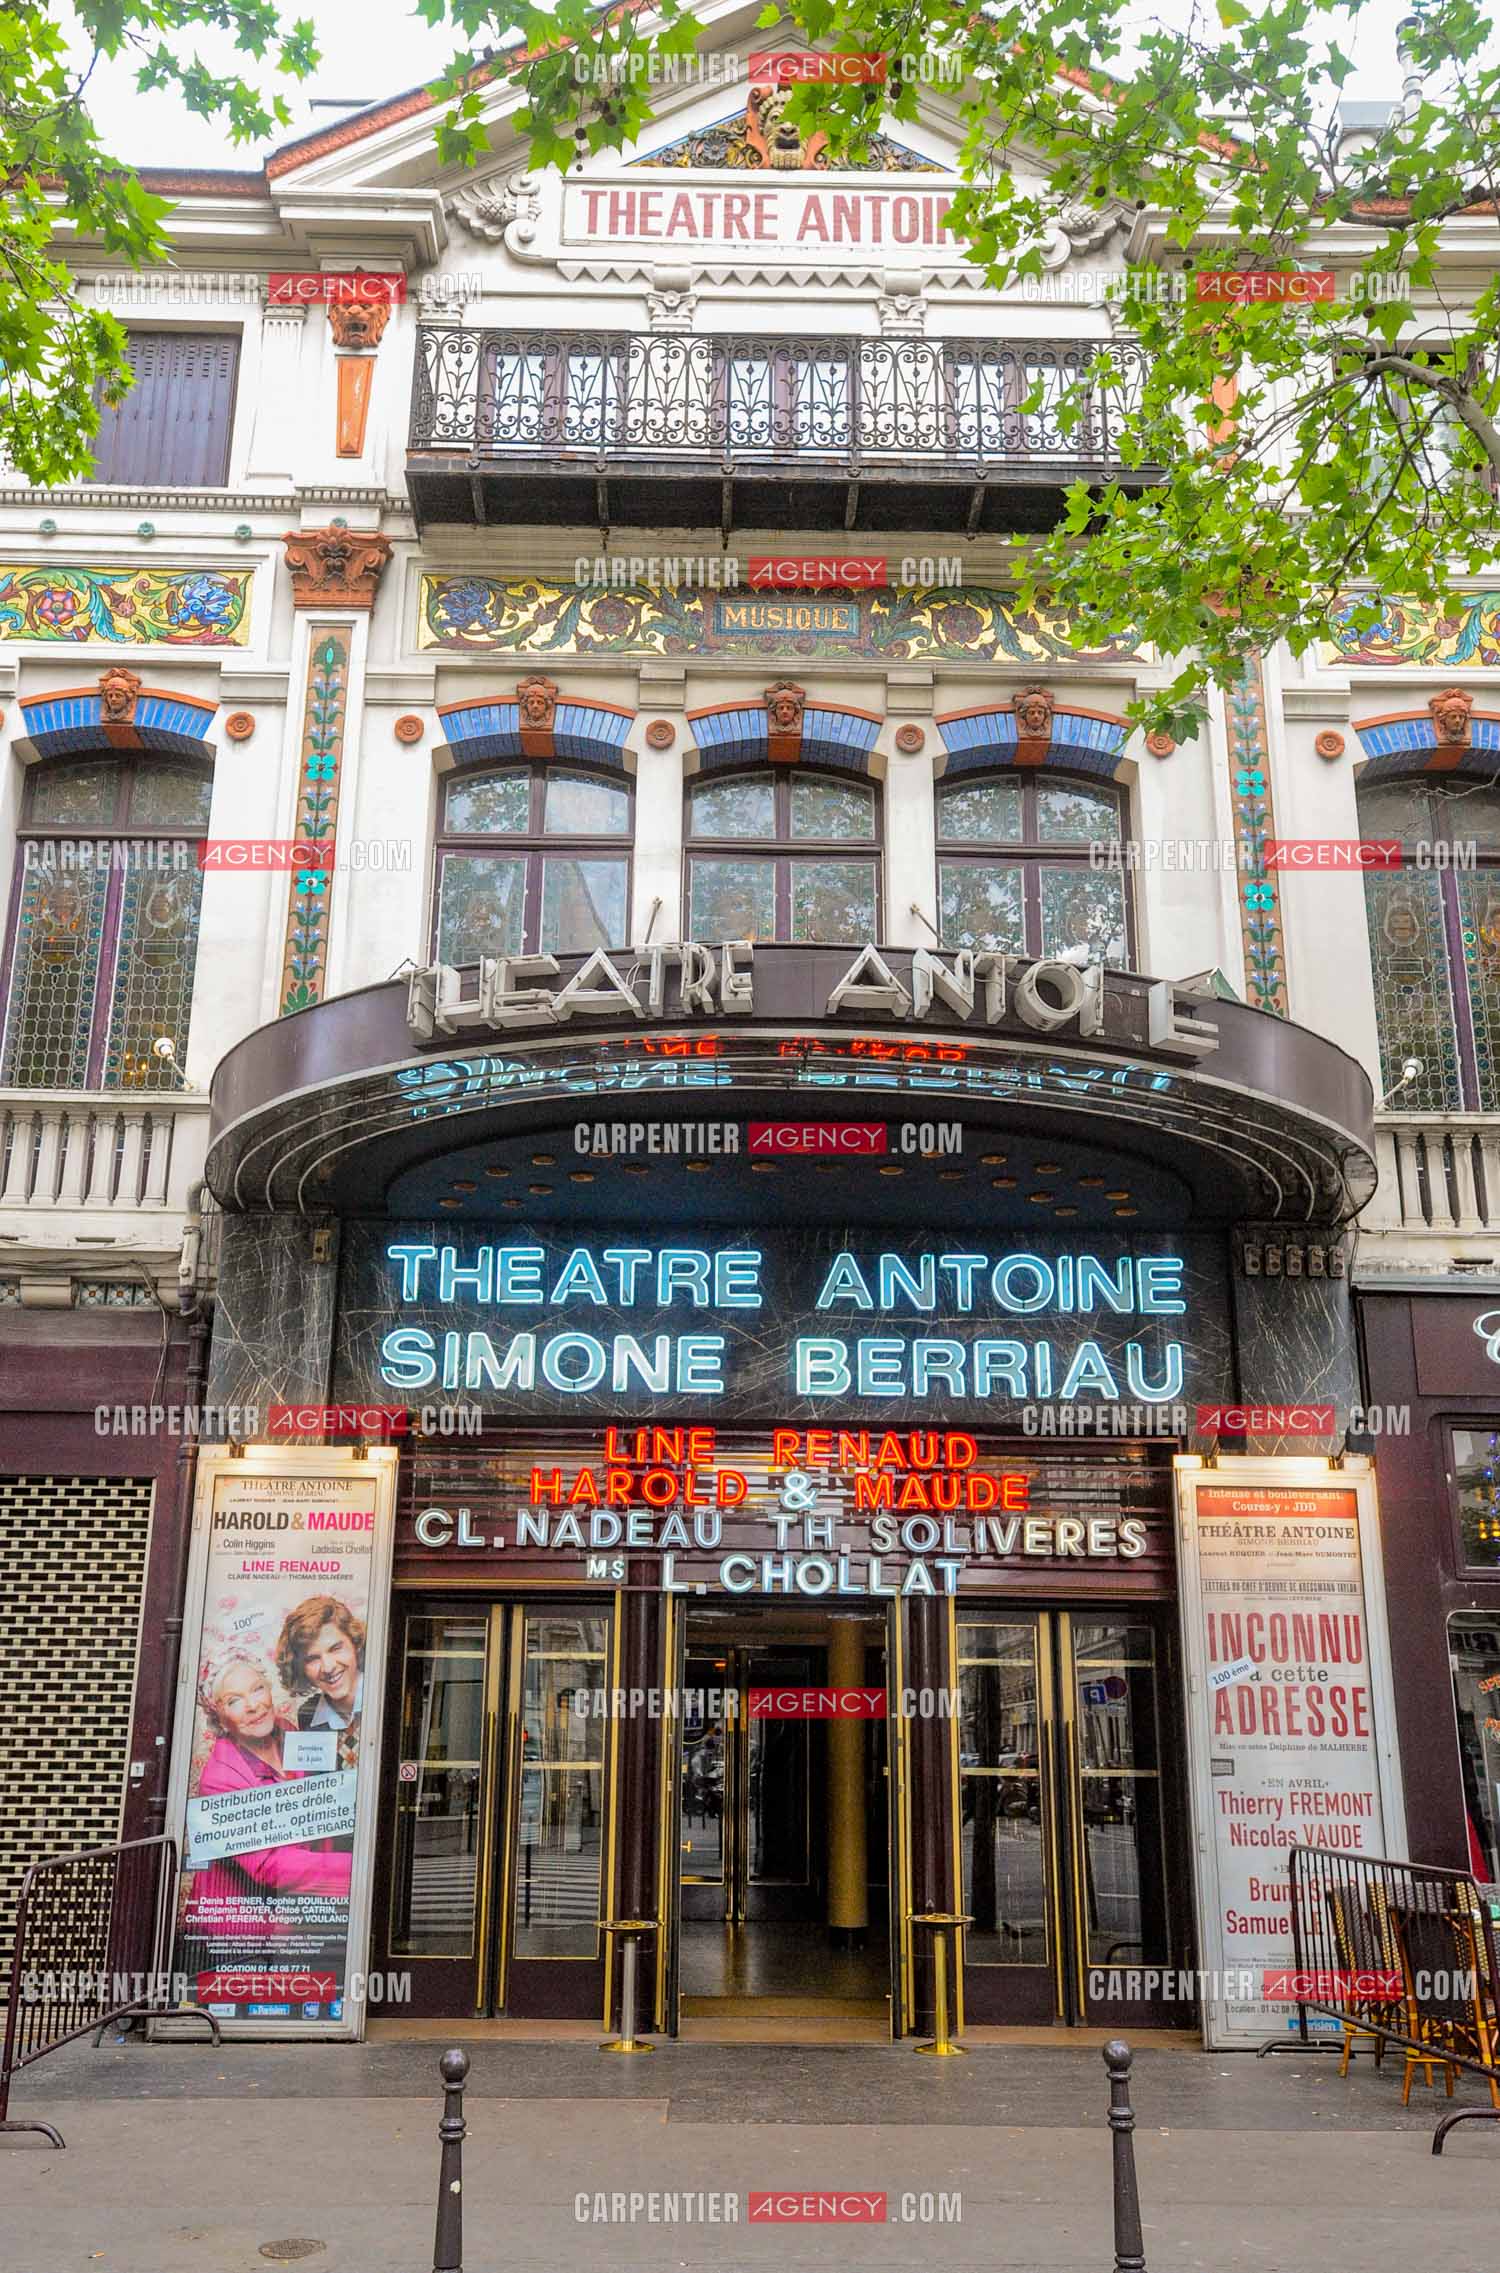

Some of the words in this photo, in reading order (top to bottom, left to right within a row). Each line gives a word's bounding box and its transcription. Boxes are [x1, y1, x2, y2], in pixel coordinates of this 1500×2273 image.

[581, 189, 778, 241] THEATRE
[796, 194, 968, 245] ANTOIN
[724, 605, 849, 631] MUSIQUE
[400, 940, 753, 1038] THEATRE
[387, 1245, 762, 1307] THEATRE
[815, 1253, 1186, 1314] ANTOINE
[380, 1328, 725, 1393] SIMONE
[796, 1337, 1184, 1402] BERRIAU
[604, 1427, 715, 1465] LINE
[773, 1428, 978, 1470] RENAUD
[529, 1467, 748, 1506] HAROLD
[779, 1470, 818, 1510] &
[854, 1472, 1029, 1511] MAUDE
[1292, 1502, 1316, 1512] JDD
[214, 1511, 289, 1530] HAROLD
[290, 1512, 304, 1529] &
[307, 1512, 375, 1530] MAUDE
[1199, 1522, 1276, 1538] THÉÂTRE
[1282, 1527, 1355, 1539] ANTOINE
[223, 1539, 243, 1549] Colin
[245, 1539, 275, 1551] Higgins
[768, 1512, 851, 1553] TH.
[871, 1514, 1147, 1558] SOLIVERES
[242, 1561, 274, 1572] LINE
[279, 1561, 341, 1572] RENAUD
[587, 1559, 625, 1579] MS
[1207, 1613, 1362, 1664] INCONNU
[1212, 1670, 1231, 1685] 100
[1271, 1666, 1329, 1682] cette
[1215, 1685, 1370, 1737] ADRESSE
[1320, 1743, 1368, 1752] MALHERBE
[200, 1788, 271, 1812] Distribution
[275, 1777, 337, 1797] excellente
[1288, 1779, 1325, 1789] AVRIL
[211, 1805, 271, 1826] Spectacle
[275, 1800, 298, 1814] très
[302, 1793, 337, 1808] drôle,
[1218, 1791, 1283, 1821] Thierry
[1289, 1792, 1373, 1817] FREMONT
[194, 1822, 257, 1844] émouvant
[261, 1819, 286, 1831] et...
[290, 1804, 350, 1827] optimiste
[1230, 1823, 1297, 1847] Nicolas
[1302, 1824, 1363, 1849] VAUDE
[224, 1837, 262, 1852] Armelle
[265, 1831, 293, 1845] Héliot
[303, 1826, 317, 1838] LE
[198, 1905, 237, 1915] Benjamin
[239, 1905, 273, 1915] BOYER,
[275, 1905, 300, 1914] Chloé
[200, 1897, 224, 1905] Denis
[226, 1897, 265, 1906] BERNER,
[266, 1897, 296, 1907] Sophie
[185, 1914, 224, 1923] Christian
[226, 1914, 267, 1924] PEREIRA,
[268, 1914, 303, 1924] Grégory
[305, 1914, 349, 1923] VOULAND
[215, 1964, 257, 1972] LOCATION
[258, 1964, 267, 1972] 01
